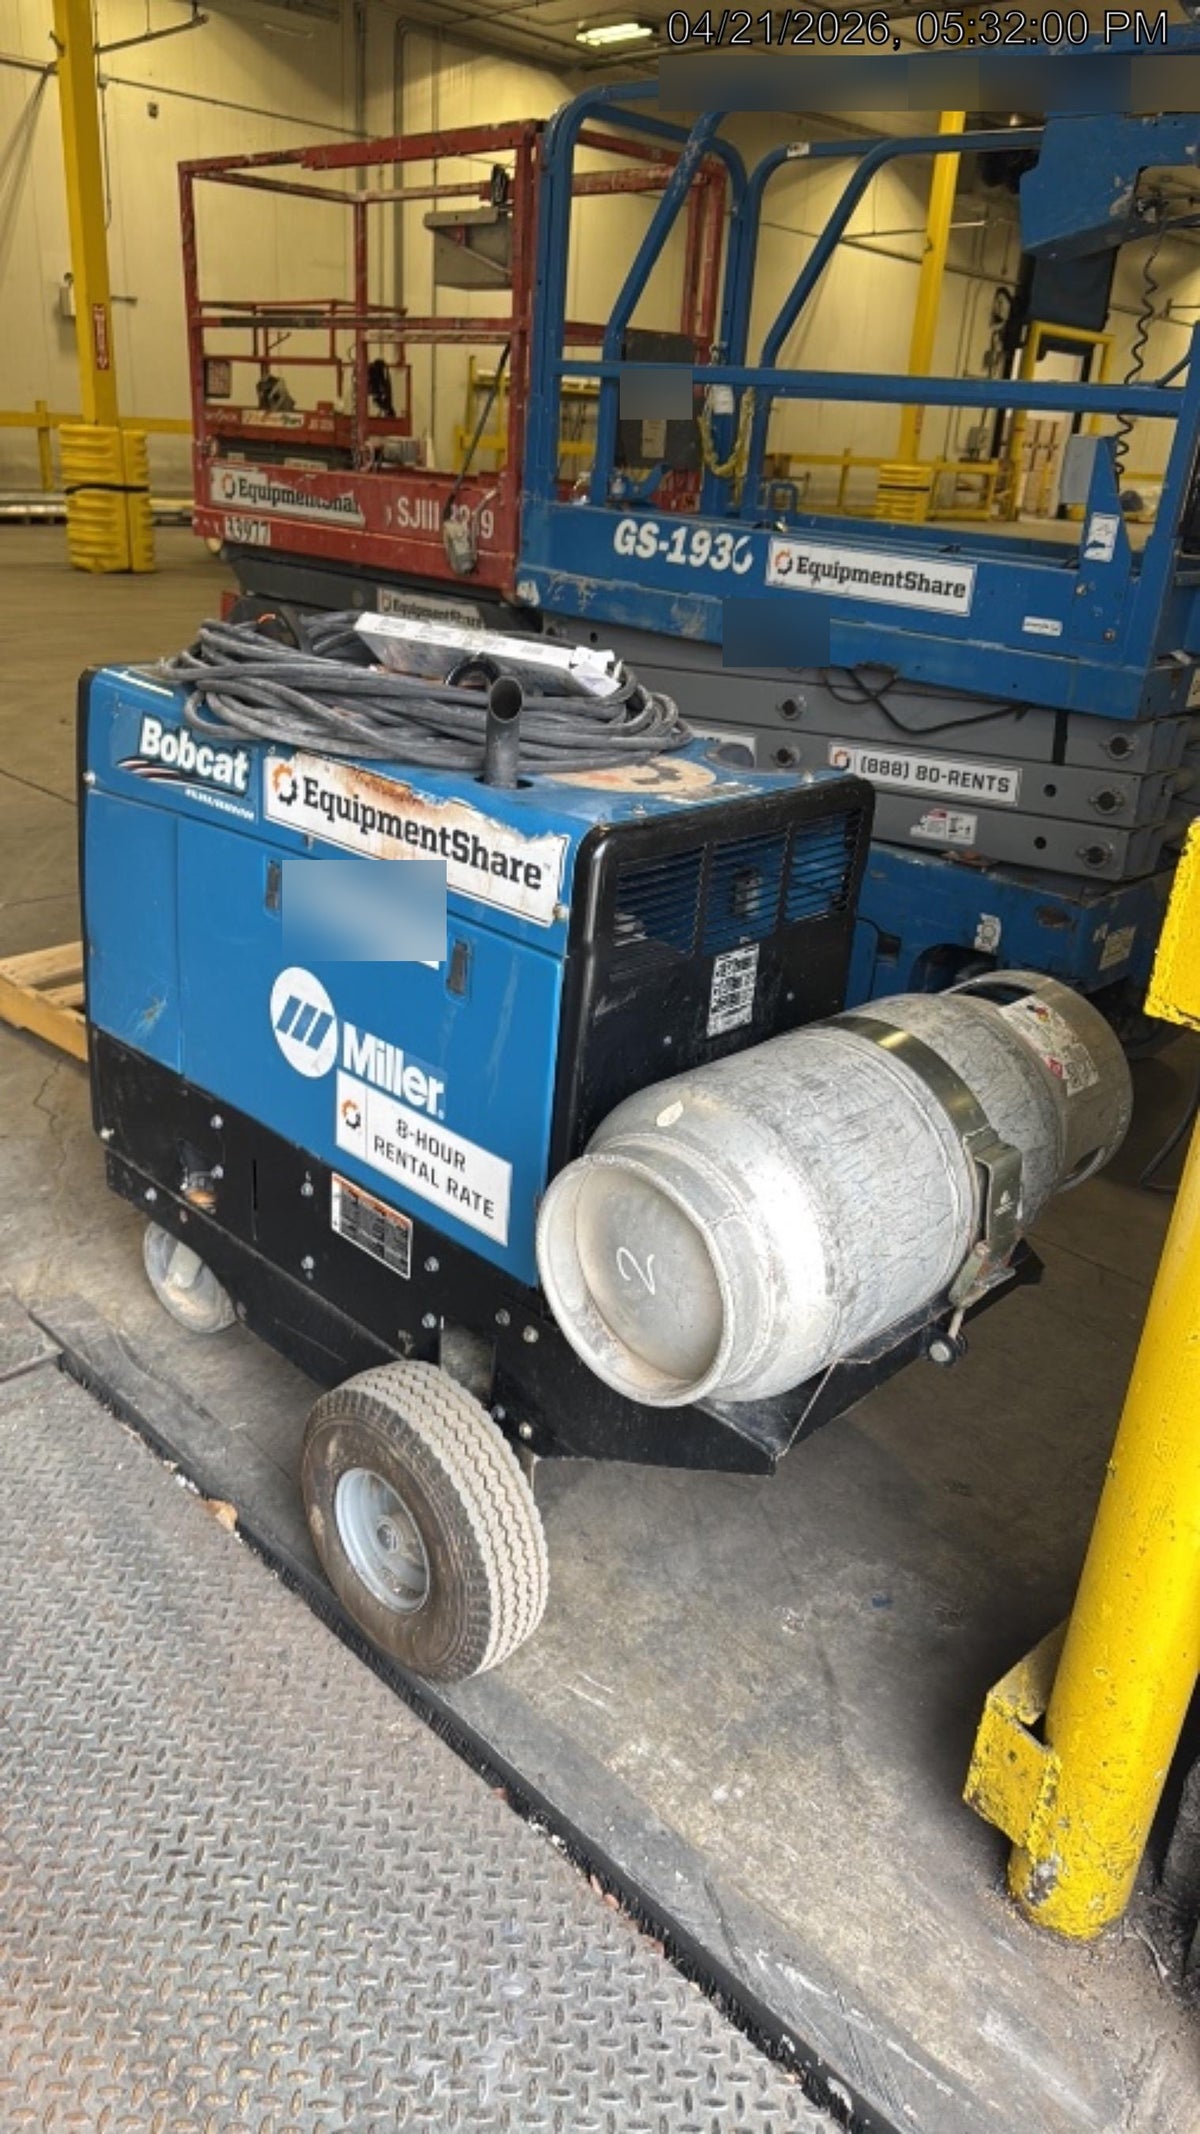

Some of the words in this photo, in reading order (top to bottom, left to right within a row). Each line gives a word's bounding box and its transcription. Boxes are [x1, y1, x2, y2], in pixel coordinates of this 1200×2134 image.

[796, 555, 966, 599] EquipmentShare
[140, 715, 249, 791] Bobcat
[860, 756, 909, 780] (888)
[915, 765, 1011, 794] 80-RENTS
[303, 776, 542, 890] EquipmentShare
[396, 1118, 466, 1172] 8-HOUR
[373, 1135, 440, 1189] RENTAL
[446, 1176, 496, 1220] RATE
[616, 1246, 656, 1296] 2
